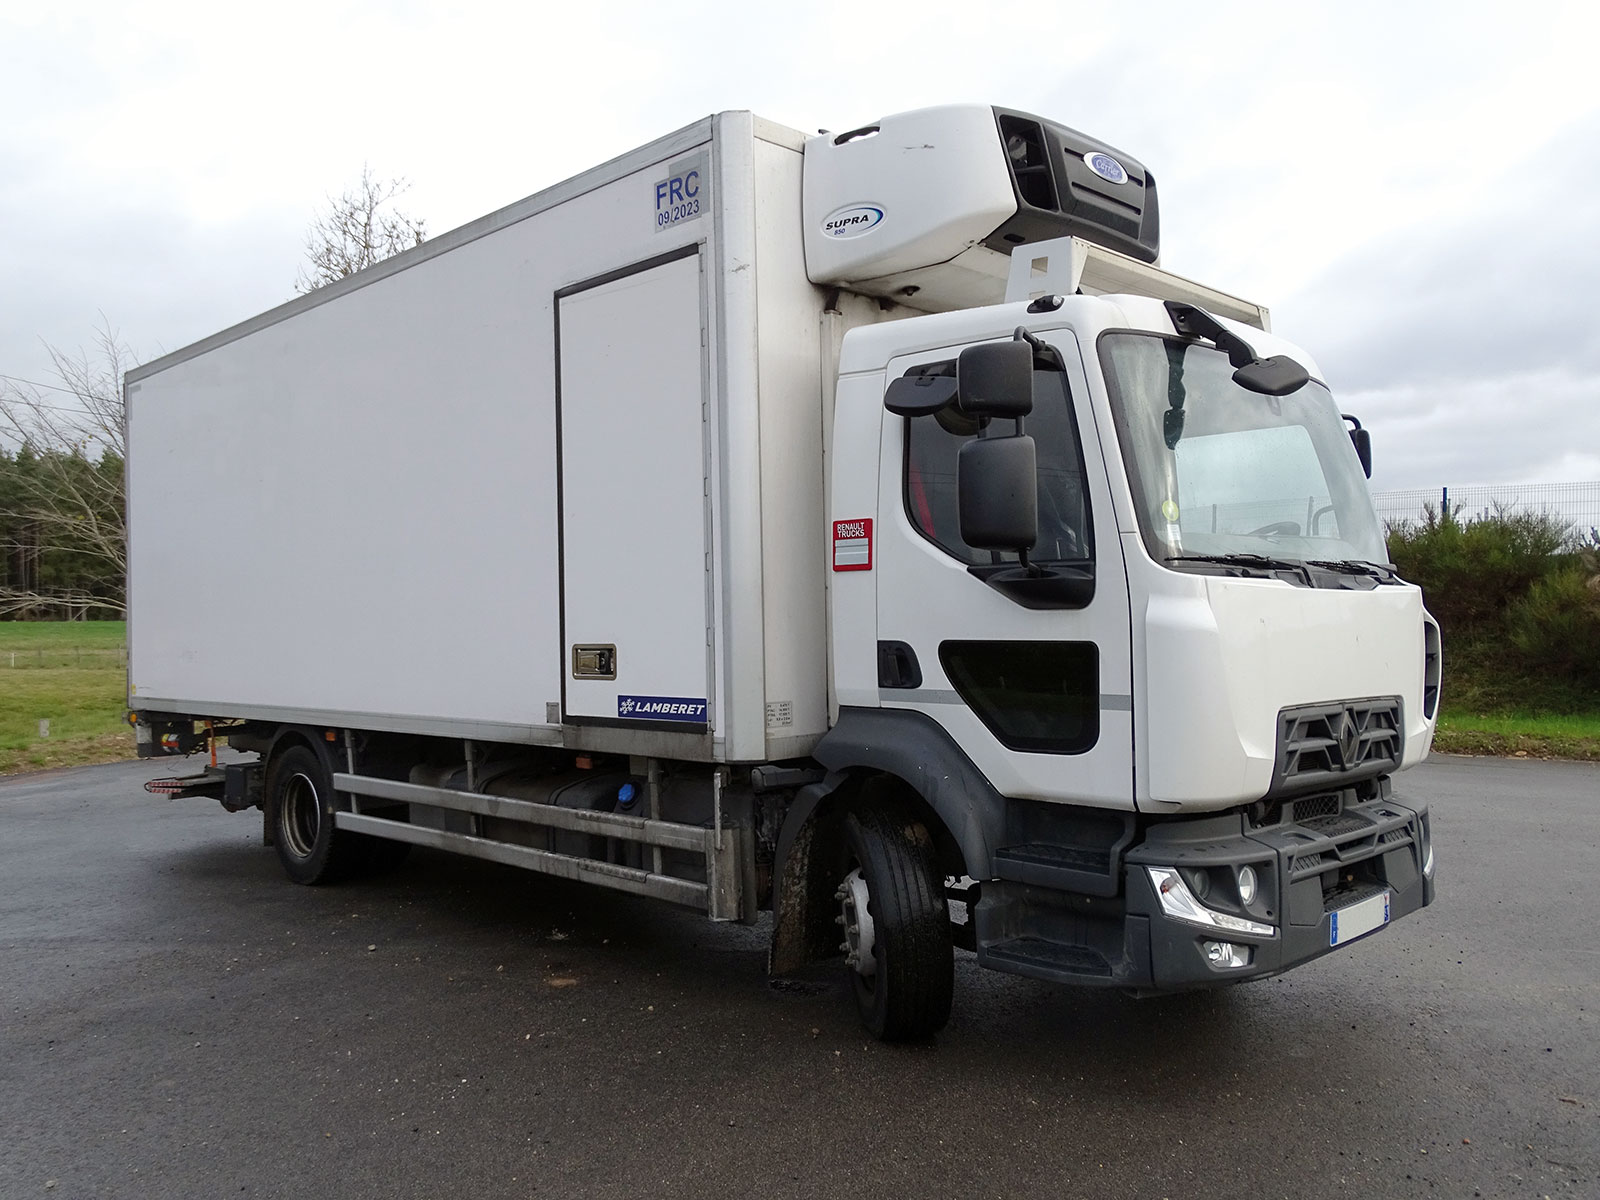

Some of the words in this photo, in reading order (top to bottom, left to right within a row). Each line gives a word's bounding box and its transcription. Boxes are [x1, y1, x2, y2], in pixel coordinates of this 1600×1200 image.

[657, 171, 699, 210] FRC
[658, 199, 700, 226] 09/2023
[826, 214, 869, 230] SUPRA
[837, 522, 865, 531] RENAULT
[837, 529, 865, 538] TRUCKS
[635, 702, 705, 715] LAMBERET
